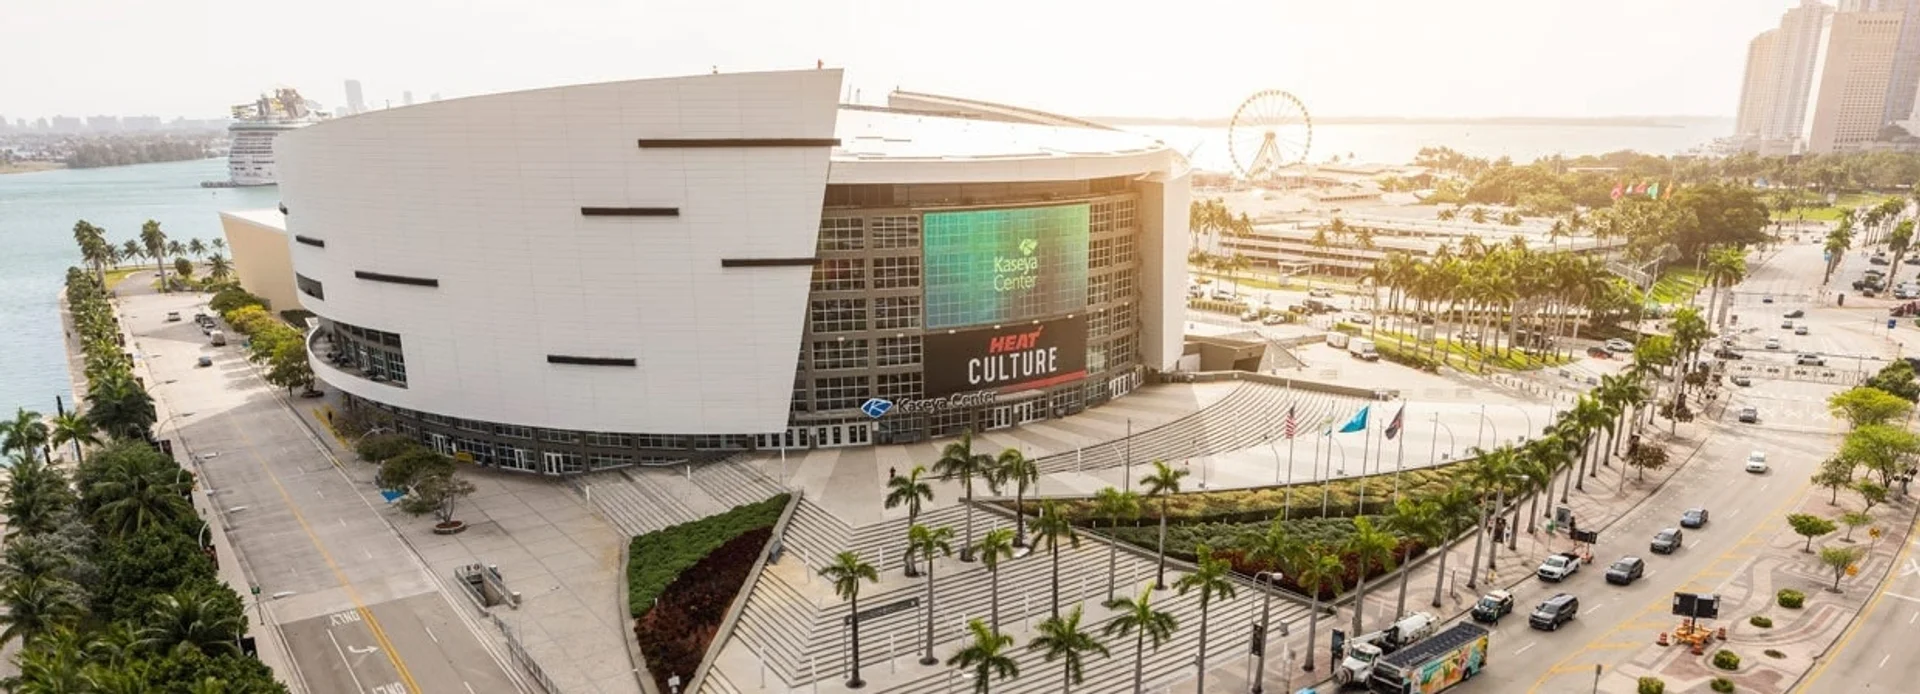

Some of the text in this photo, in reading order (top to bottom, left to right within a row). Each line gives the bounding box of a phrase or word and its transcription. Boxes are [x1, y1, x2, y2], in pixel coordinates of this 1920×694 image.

[994, 256, 1038, 275] Kaseya
[994, 274, 1038, 292] Center
[989, 325, 1044, 353] HEAT
[968, 347, 1057, 385] CULTURE
[896, 390, 998, 414] Kaseya Center
[330, 609, 361, 627] ONLY
